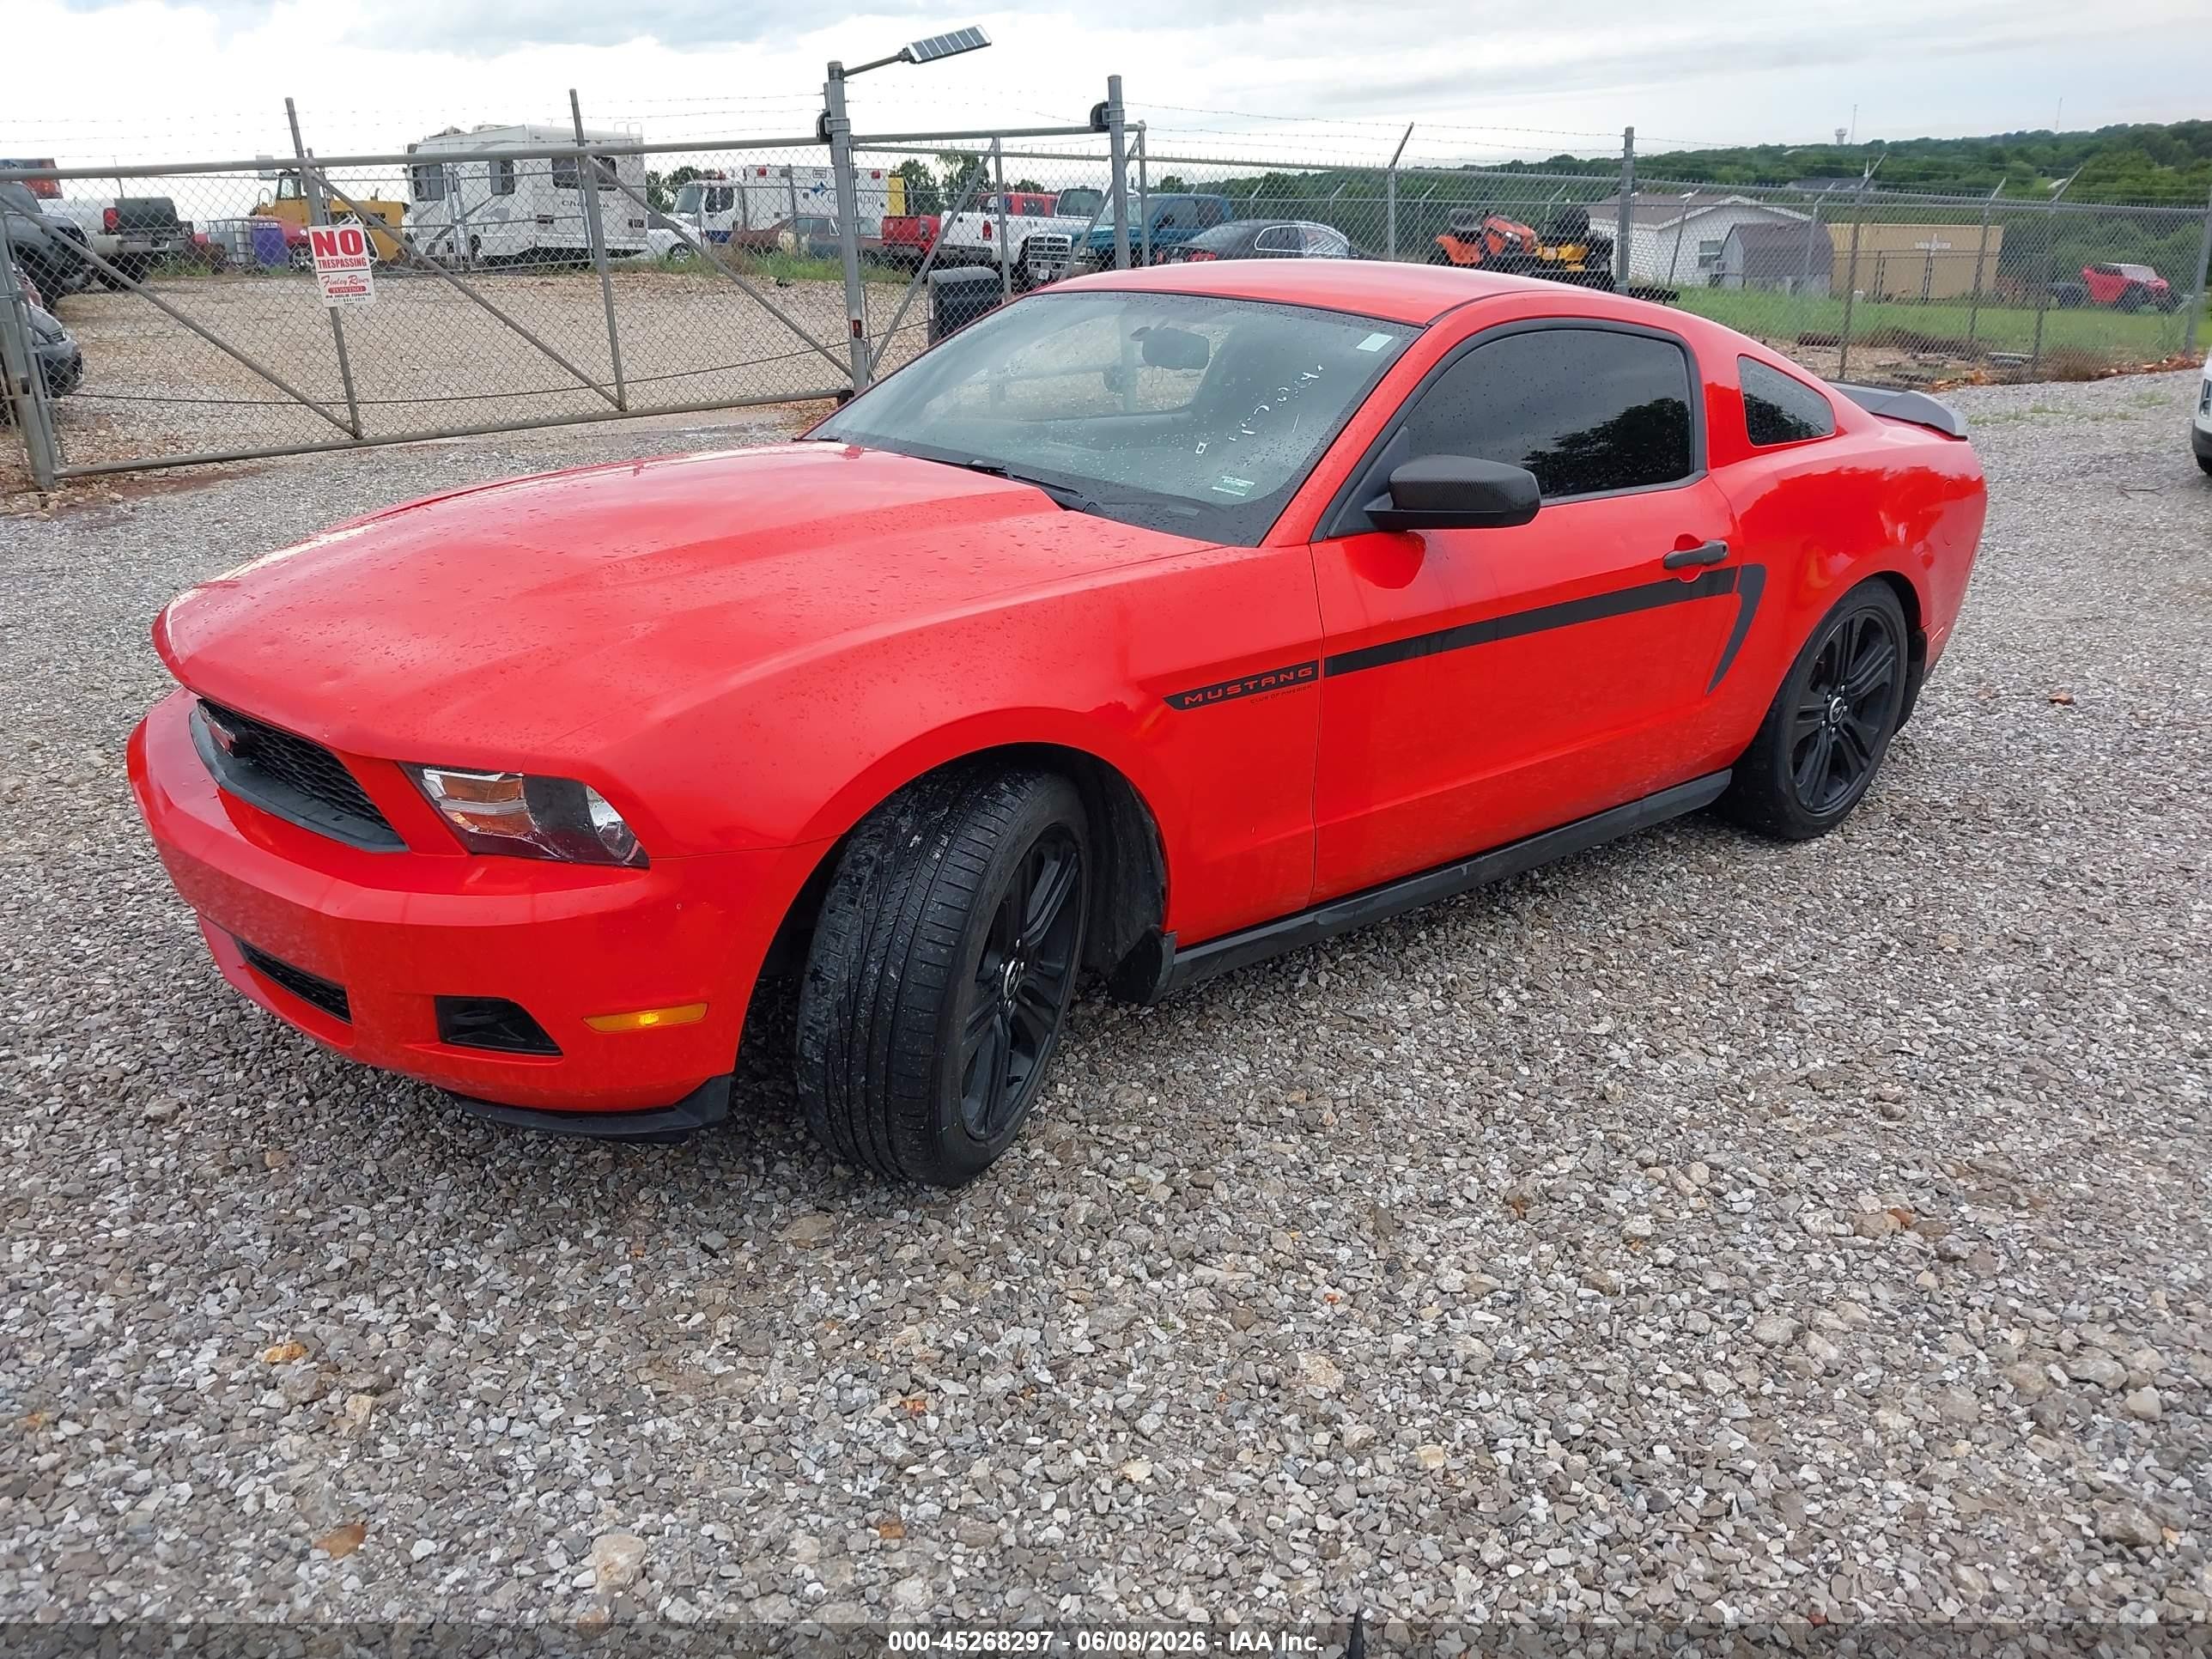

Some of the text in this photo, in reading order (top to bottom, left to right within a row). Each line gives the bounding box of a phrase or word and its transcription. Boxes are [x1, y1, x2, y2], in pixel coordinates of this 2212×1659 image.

[312, 229, 364, 257] NO
[317, 258, 367, 269] TRESPASSING
[321, 275, 369, 288] Finley River
[1184, 666, 1313, 705] MUSTANG
